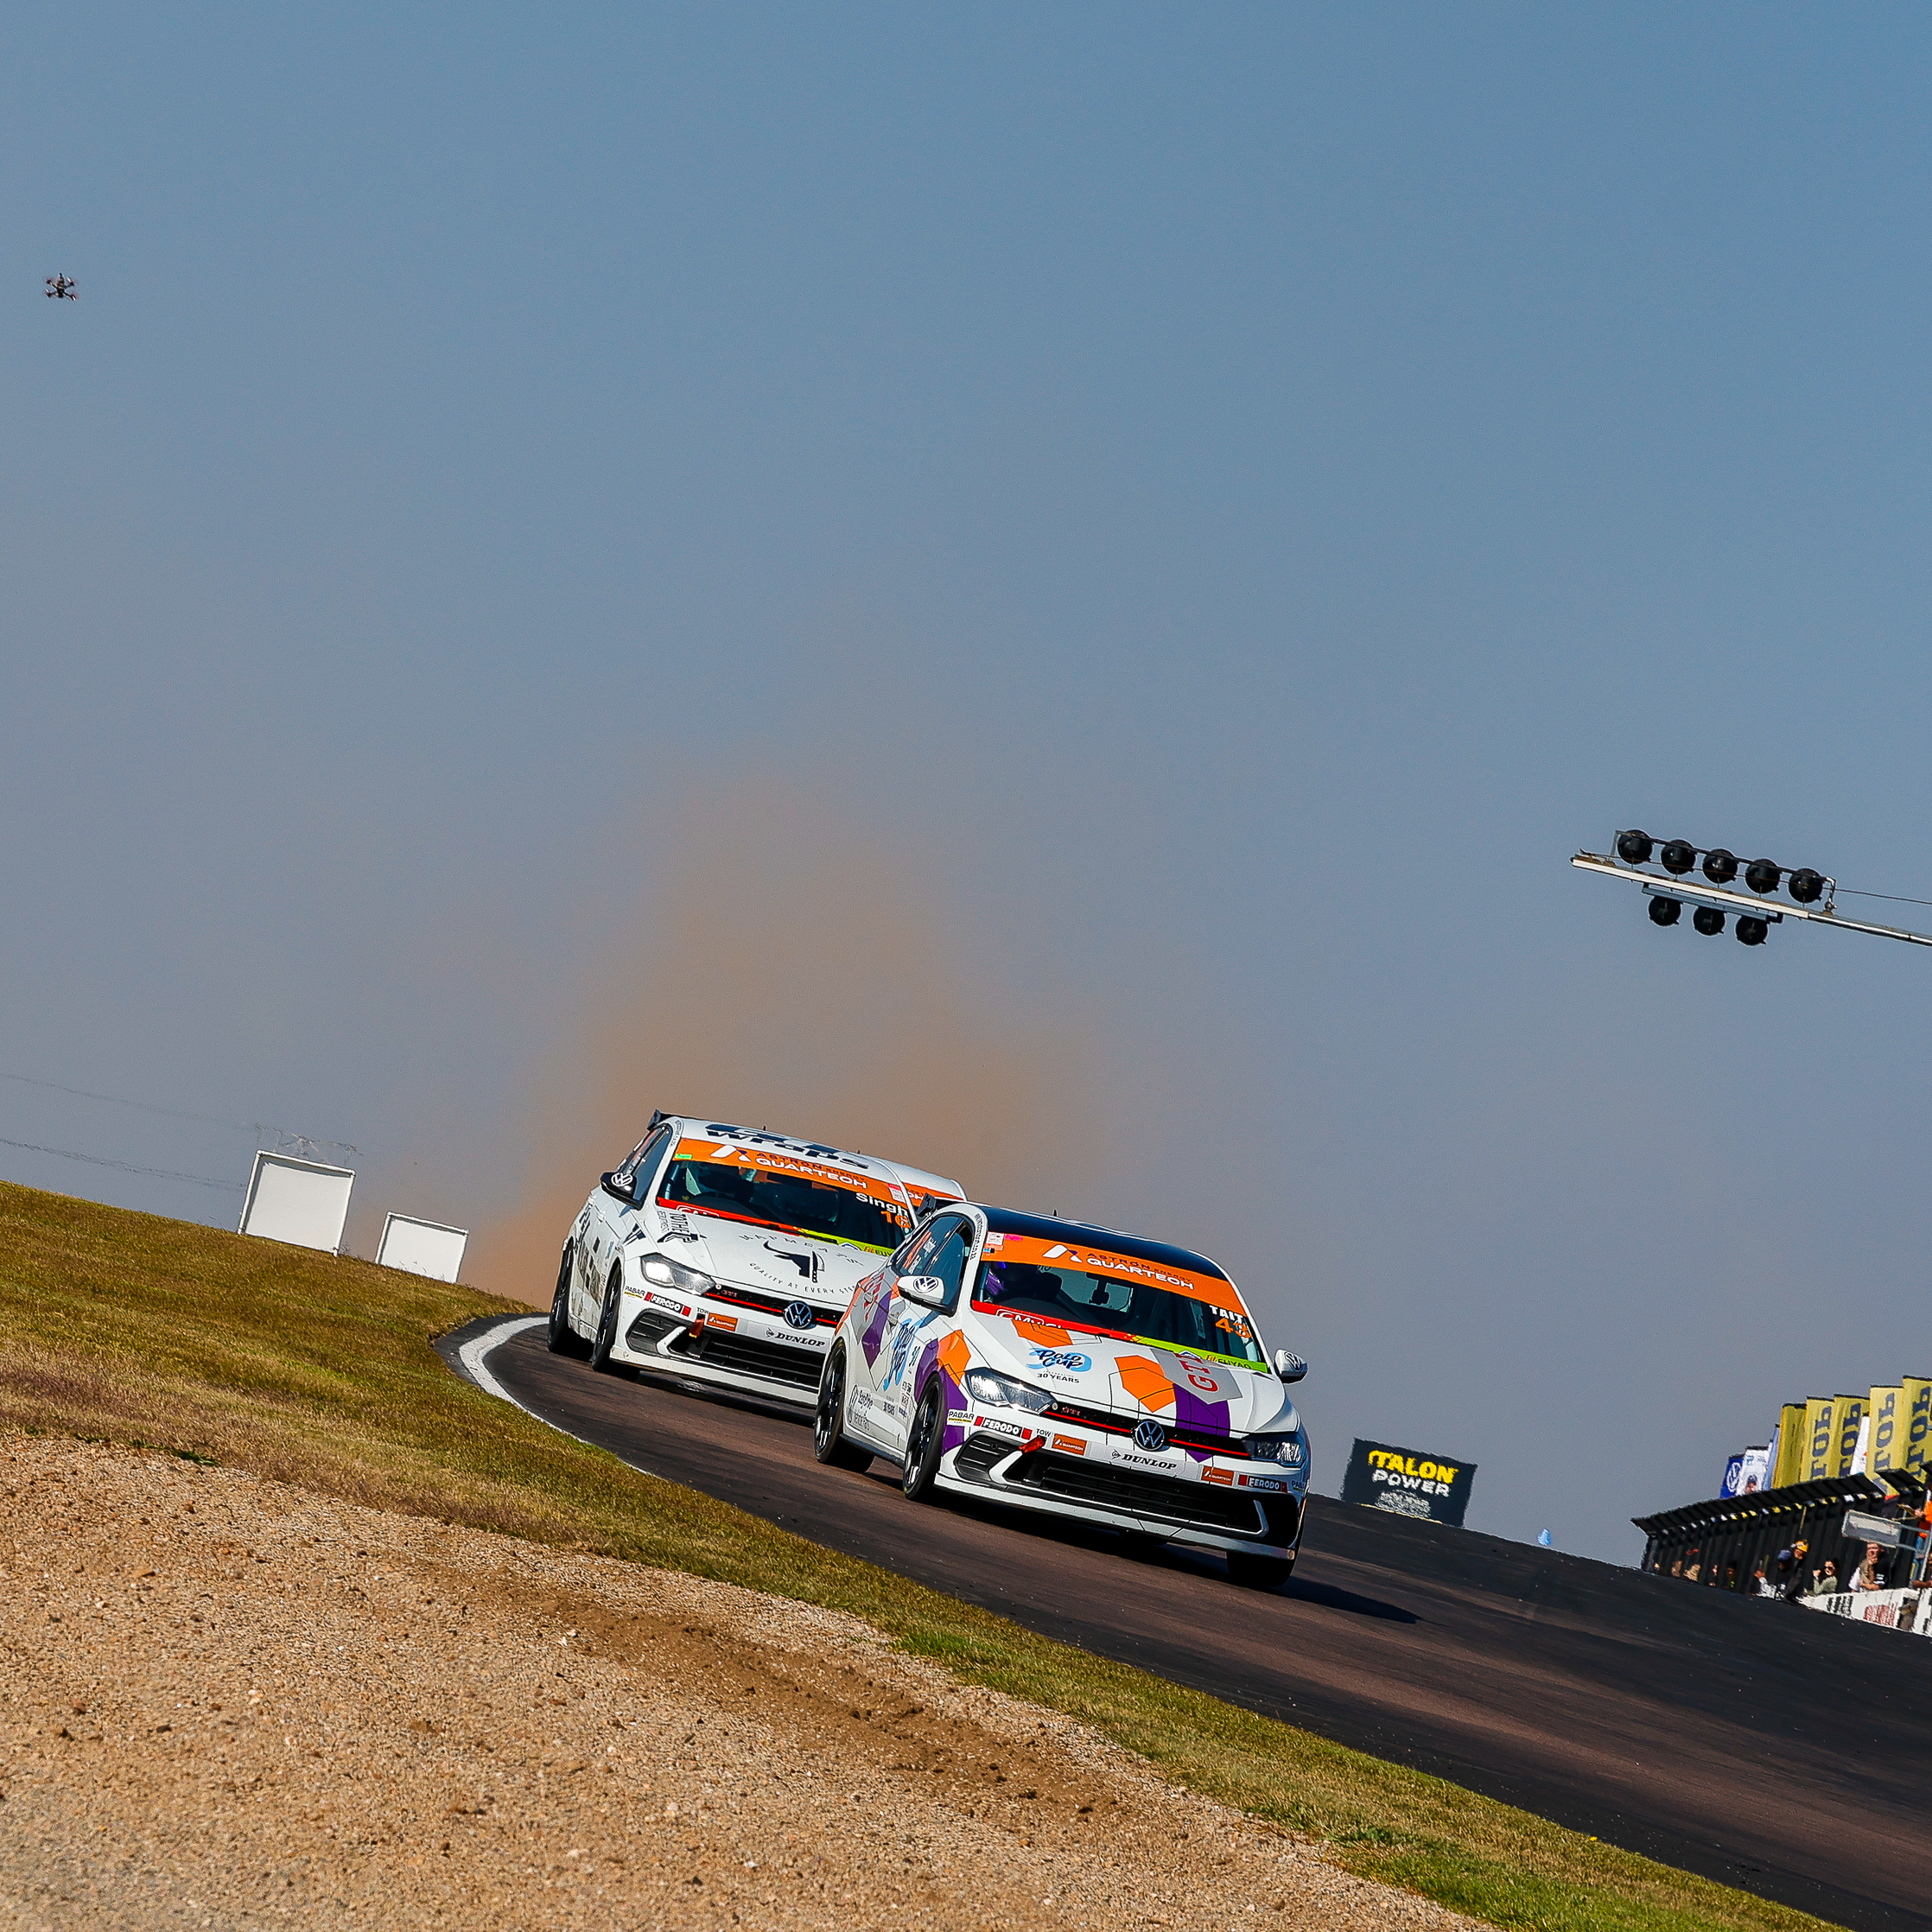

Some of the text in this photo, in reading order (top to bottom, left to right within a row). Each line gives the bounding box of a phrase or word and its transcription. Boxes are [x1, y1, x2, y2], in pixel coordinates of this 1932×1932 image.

[755, 1158, 867, 1189] QUARTECH
[855, 1192, 909, 1215] Singh
[881, 1211, 911, 1228] 16
[749, 1262, 783, 1285] QUALITY
[1086, 1257, 1194, 1289] QUARTECH
[1210, 1306, 1243, 1324] TAIT
[1215, 1318, 1252, 1338] 43
[774, 1331, 826, 1348] DUNLOP
[1051, 1373, 1080, 1383] YEARS
[949, 1410, 975, 1420] PABAR
[983, 1418, 1020, 1435] FERODO
[1036, 1428, 1052, 1437] TOW
[1122, 1453, 1177, 1471] DUNLOP
[1248, 1478, 1281, 1490] FERODO
[1372, 1469, 1452, 1497] POWER
